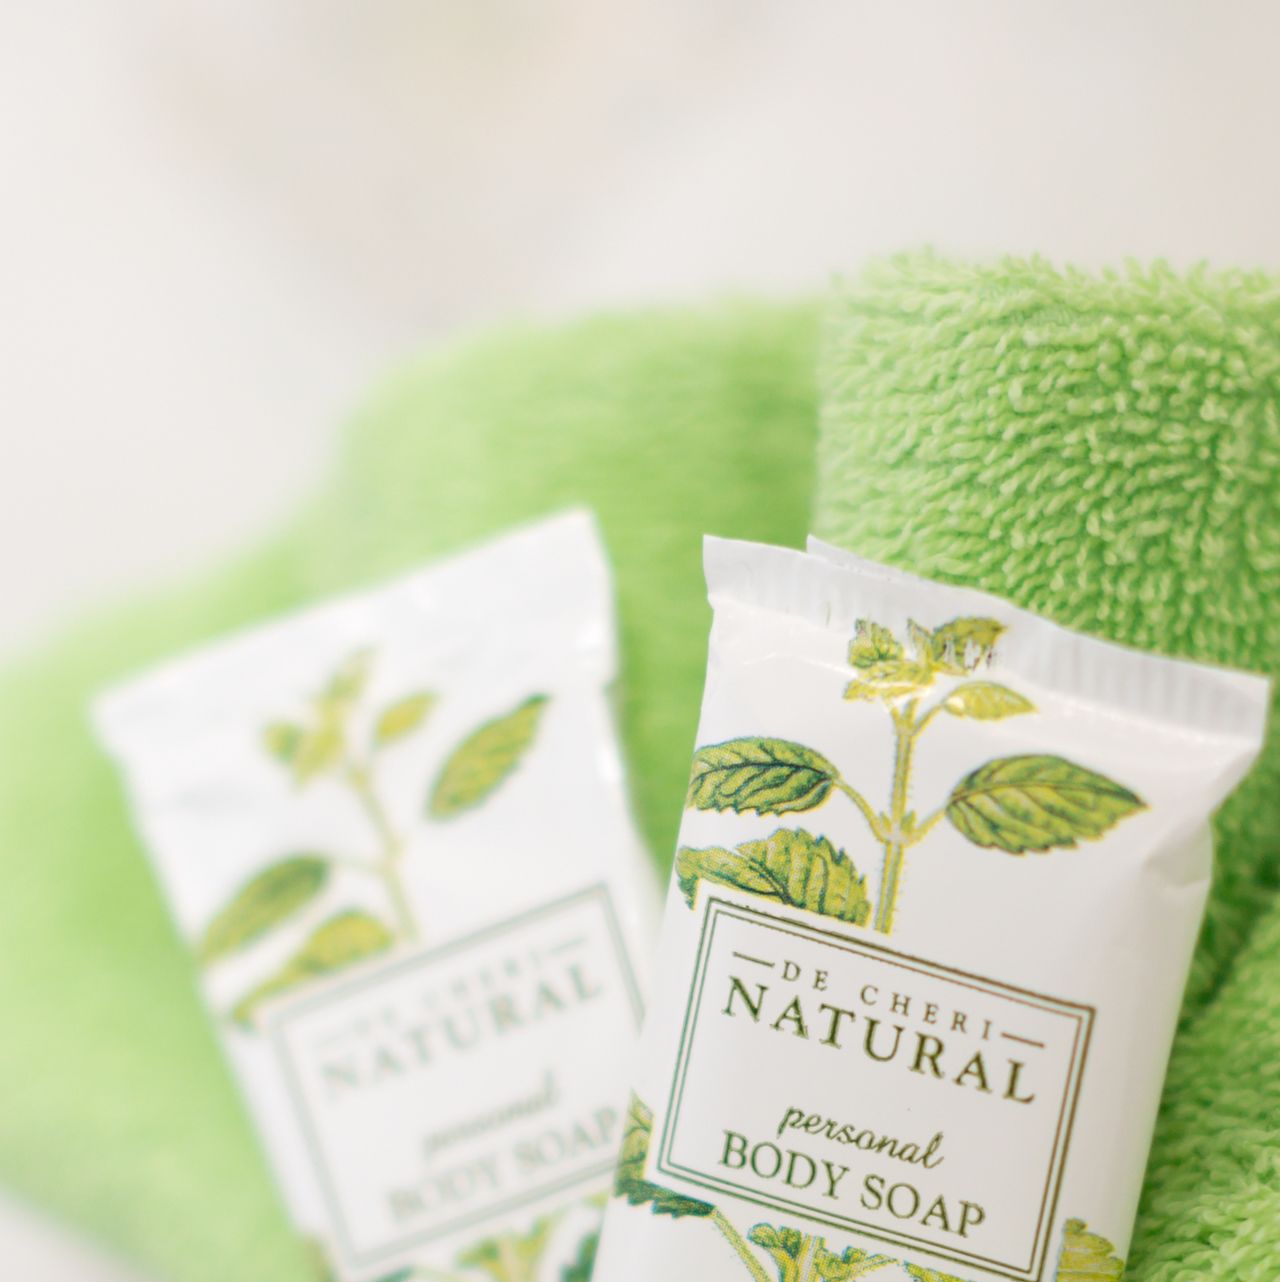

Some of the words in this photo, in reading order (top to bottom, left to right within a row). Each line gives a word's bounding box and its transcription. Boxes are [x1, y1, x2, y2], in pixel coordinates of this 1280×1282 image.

[322, 964, 604, 1092] NATURAL
[722, 976, 1036, 1104] NATURAL
[780, 959, 828, 992] DE
[859, 983, 994, 1041] CHERI
[512, 1104, 619, 1178] SOAP
[718, 1128, 850, 1201] BODY
[860, 1173, 986, 1239] SOAP
[776, 1104, 945, 1170] personal
